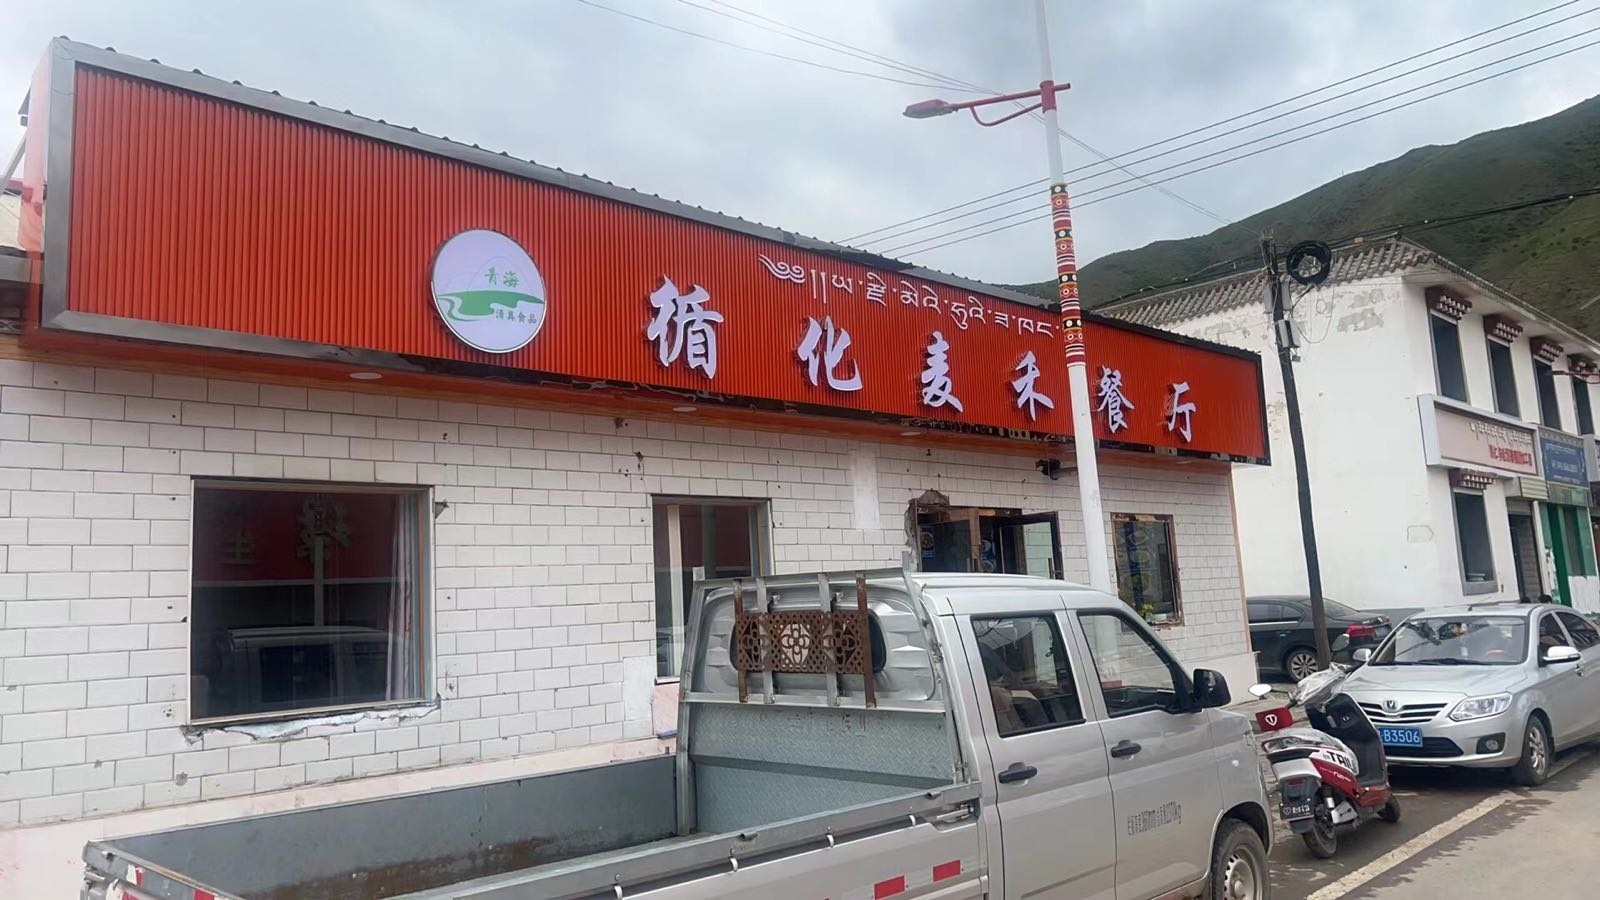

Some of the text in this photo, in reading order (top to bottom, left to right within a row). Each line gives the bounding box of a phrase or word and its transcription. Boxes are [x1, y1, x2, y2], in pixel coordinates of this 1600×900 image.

[485, 266, 520, 288] 青海
[647, 274, 1195, 442] 循化麦禾餐厅
